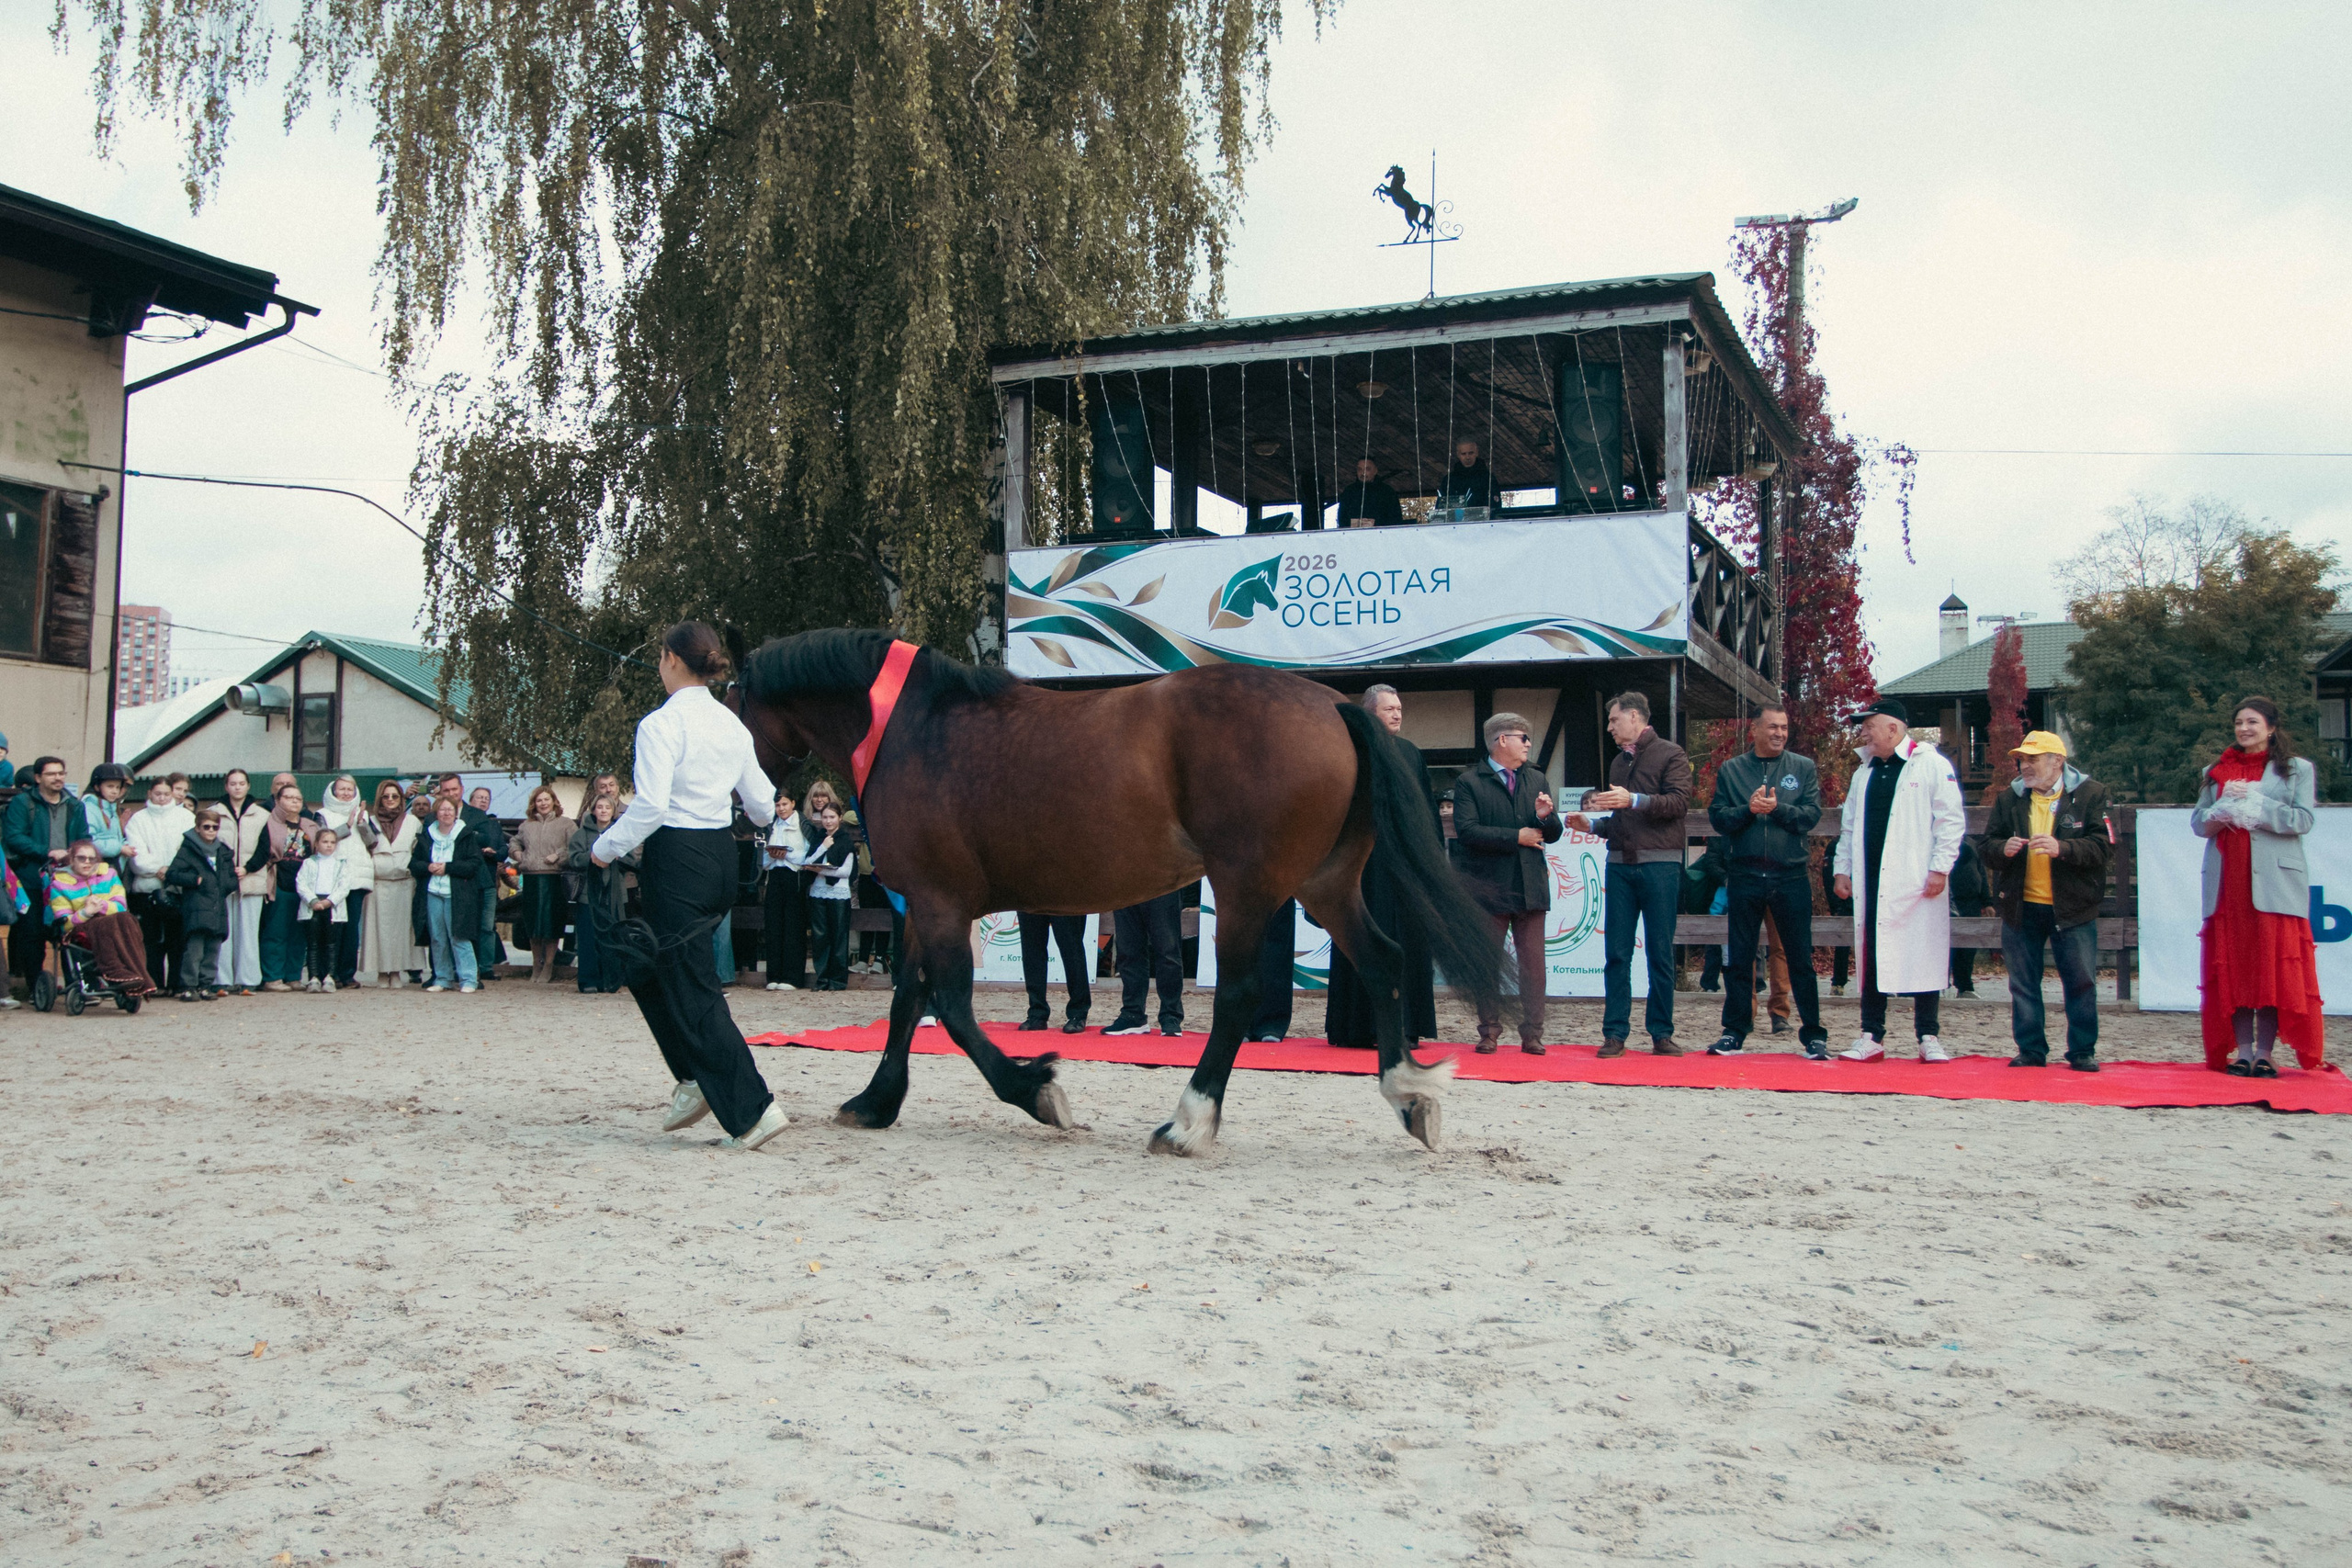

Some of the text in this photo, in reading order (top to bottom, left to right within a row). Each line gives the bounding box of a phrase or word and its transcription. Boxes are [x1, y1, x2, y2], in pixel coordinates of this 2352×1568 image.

[1284, 554, 1337, 571] 2026
[1284, 568, 1450, 600] ЗОЛОТАЯ
[1282, 599, 1402, 628] ОСЕНЬ
[1553, 964, 1605, 974] Котельник
